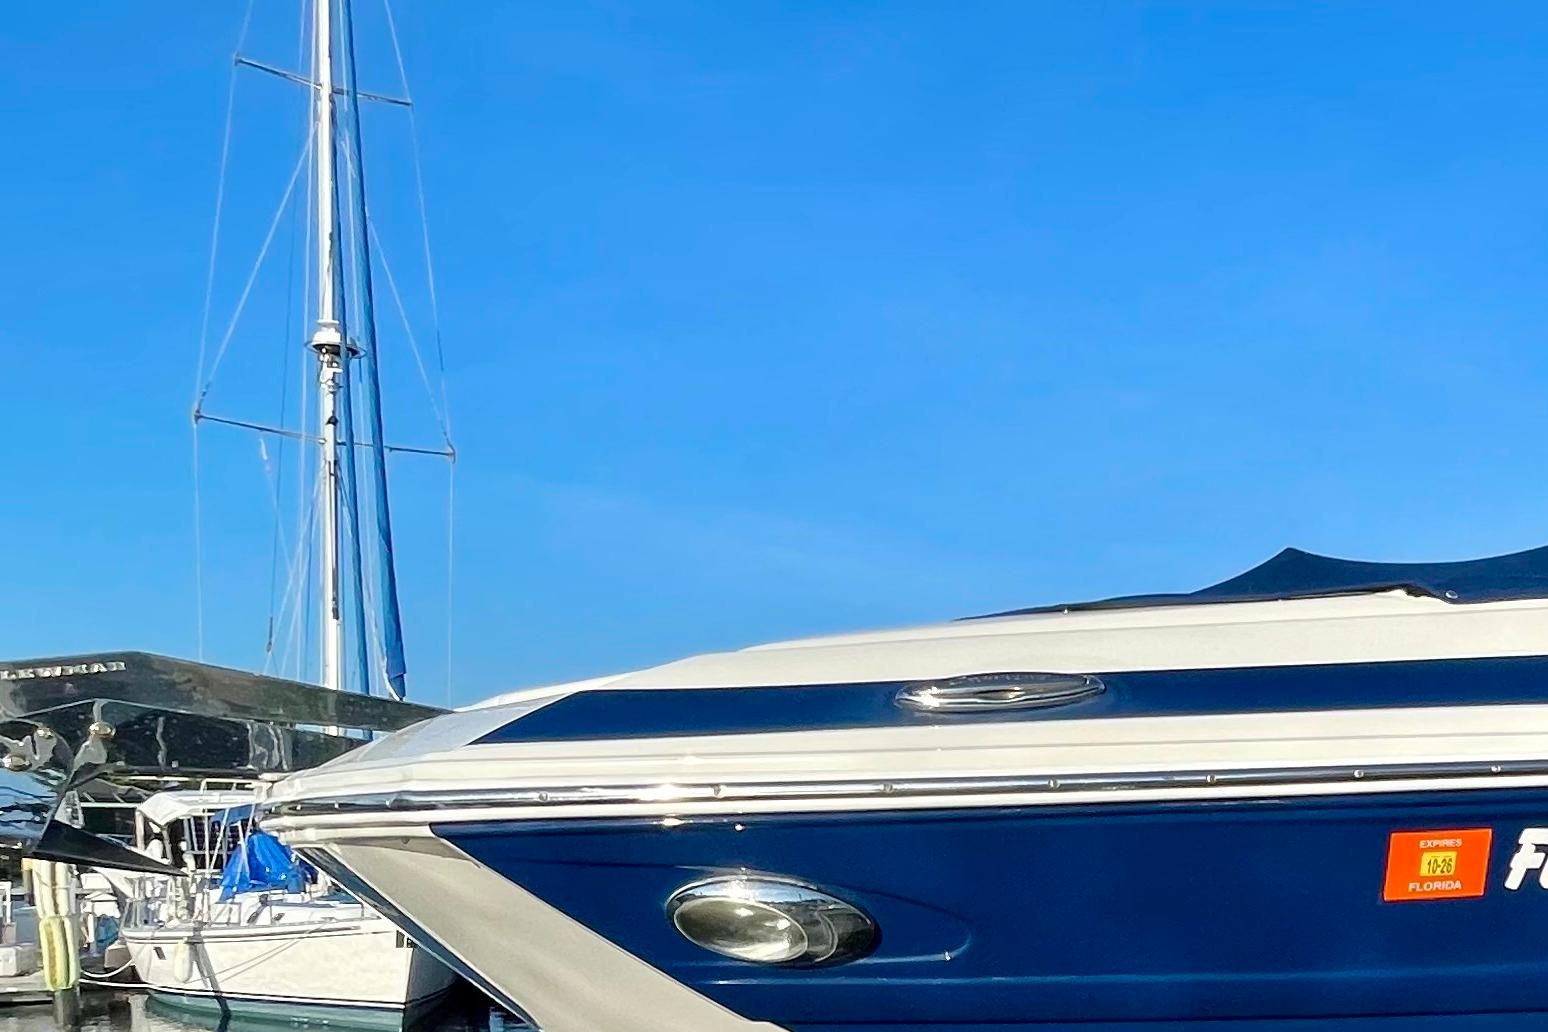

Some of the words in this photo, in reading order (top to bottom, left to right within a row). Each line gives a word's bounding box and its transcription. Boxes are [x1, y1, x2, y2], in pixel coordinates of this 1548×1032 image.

[1419, 838, 1462, 849] EXPIRES
[1427, 858, 1453, 874] 10-26
[1408, 880, 1462, 892] FLORIDA
